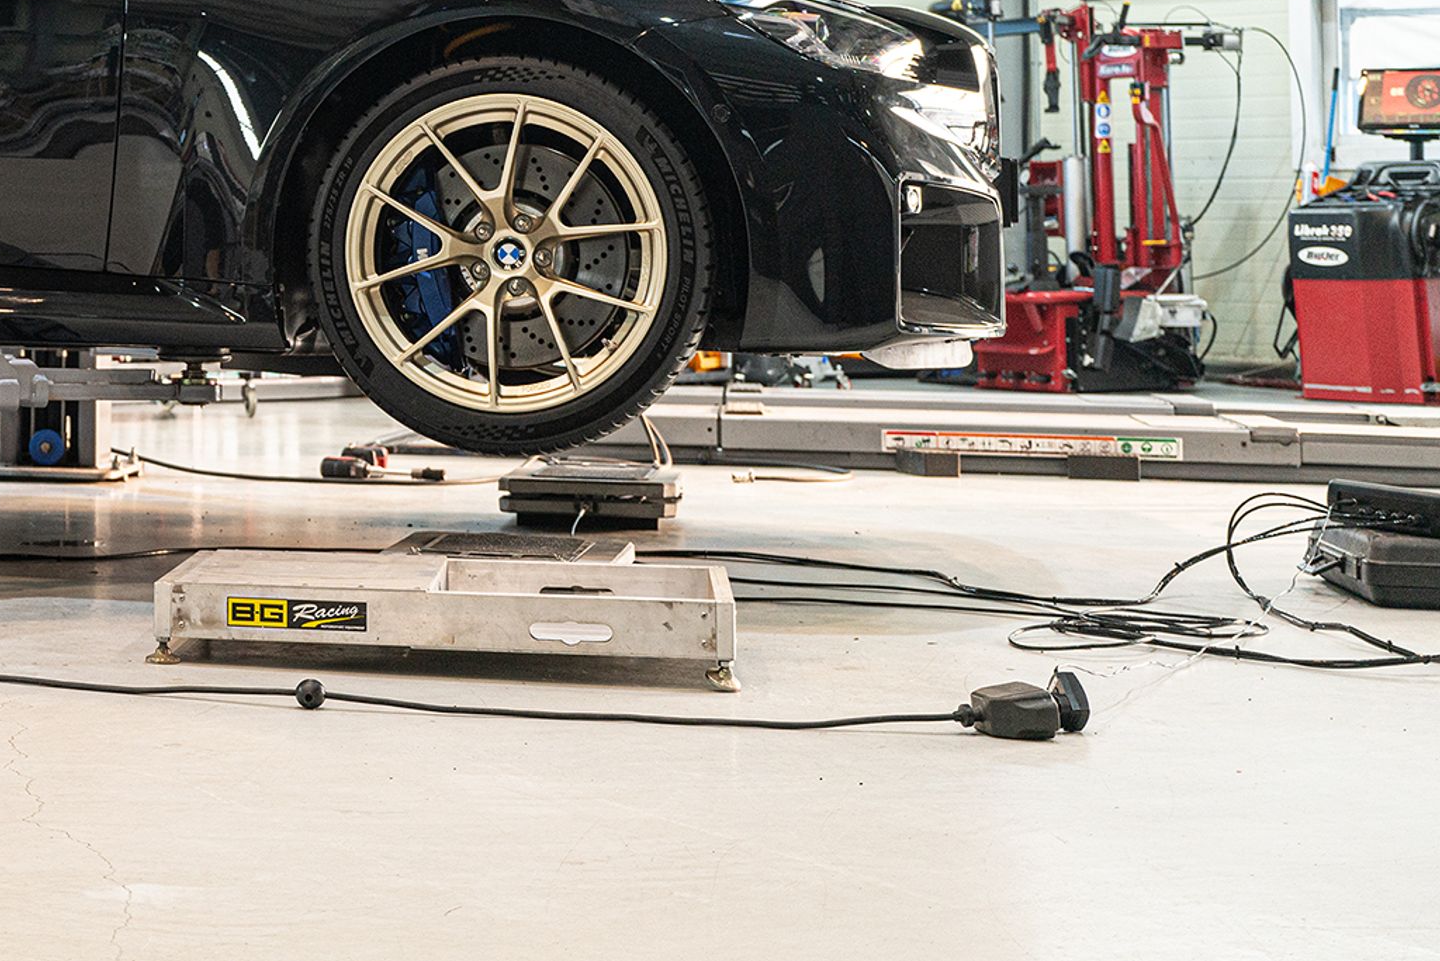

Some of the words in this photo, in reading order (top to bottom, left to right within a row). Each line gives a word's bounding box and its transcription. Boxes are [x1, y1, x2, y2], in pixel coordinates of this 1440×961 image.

[655, 152, 694, 264] MICHELIN
[320, 239, 358, 350] MICHELIN
[674, 275, 691, 311] PILOT
[659, 311, 683, 351] SPORT
[292, 603, 359, 622] Racing
